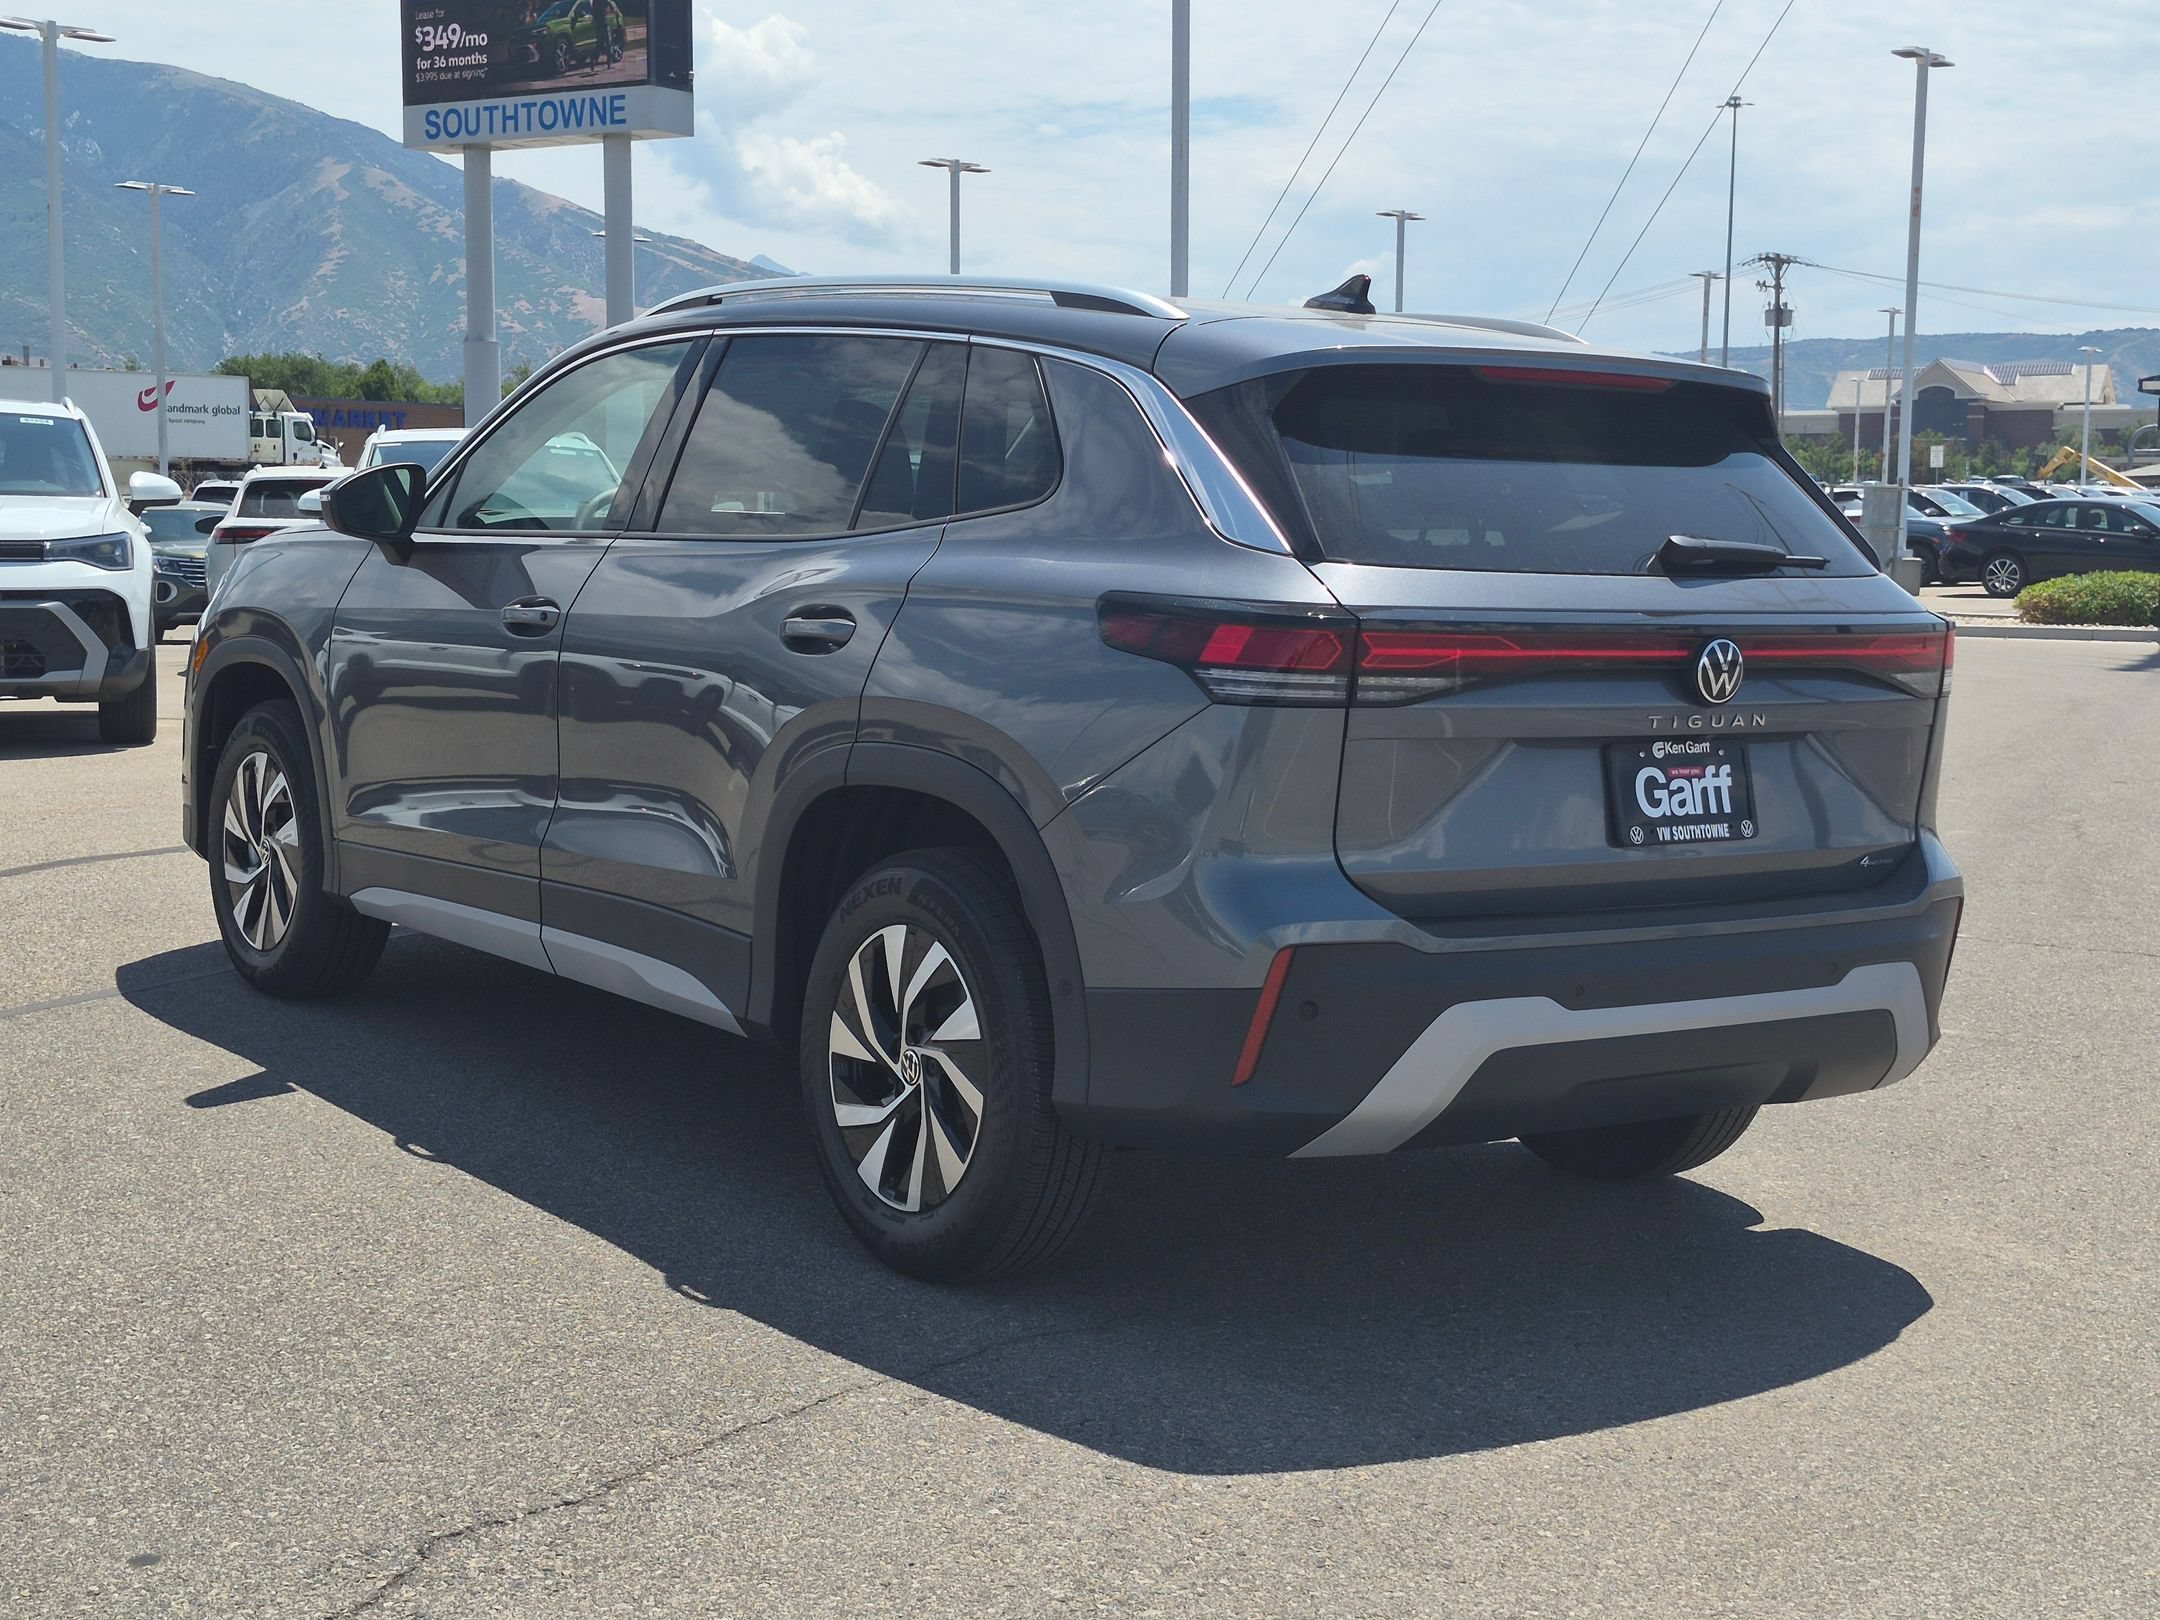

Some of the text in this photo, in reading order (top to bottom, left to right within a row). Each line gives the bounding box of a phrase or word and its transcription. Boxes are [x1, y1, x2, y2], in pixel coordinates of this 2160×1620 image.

[415, 10, 434, 20] Lease
[415, 23, 488, 51] $349/mo
[416, 52, 488, 70] for 36 months
[425, 94, 627, 140] SOUTHTOWNE
[167, 403, 209, 414] andmark
[212, 405, 240, 416] global
[1648, 713, 1766, 729] TIGUAN
[1664, 741, 1685, 754] Ken
[1685, 740, 1710, 754] Garff
[1635, 764, 1732, 818] Garff
[1657, 823, 1730, 841] VW SOUTHTOWNE
[839, 877, 903, 923] NEXEN
